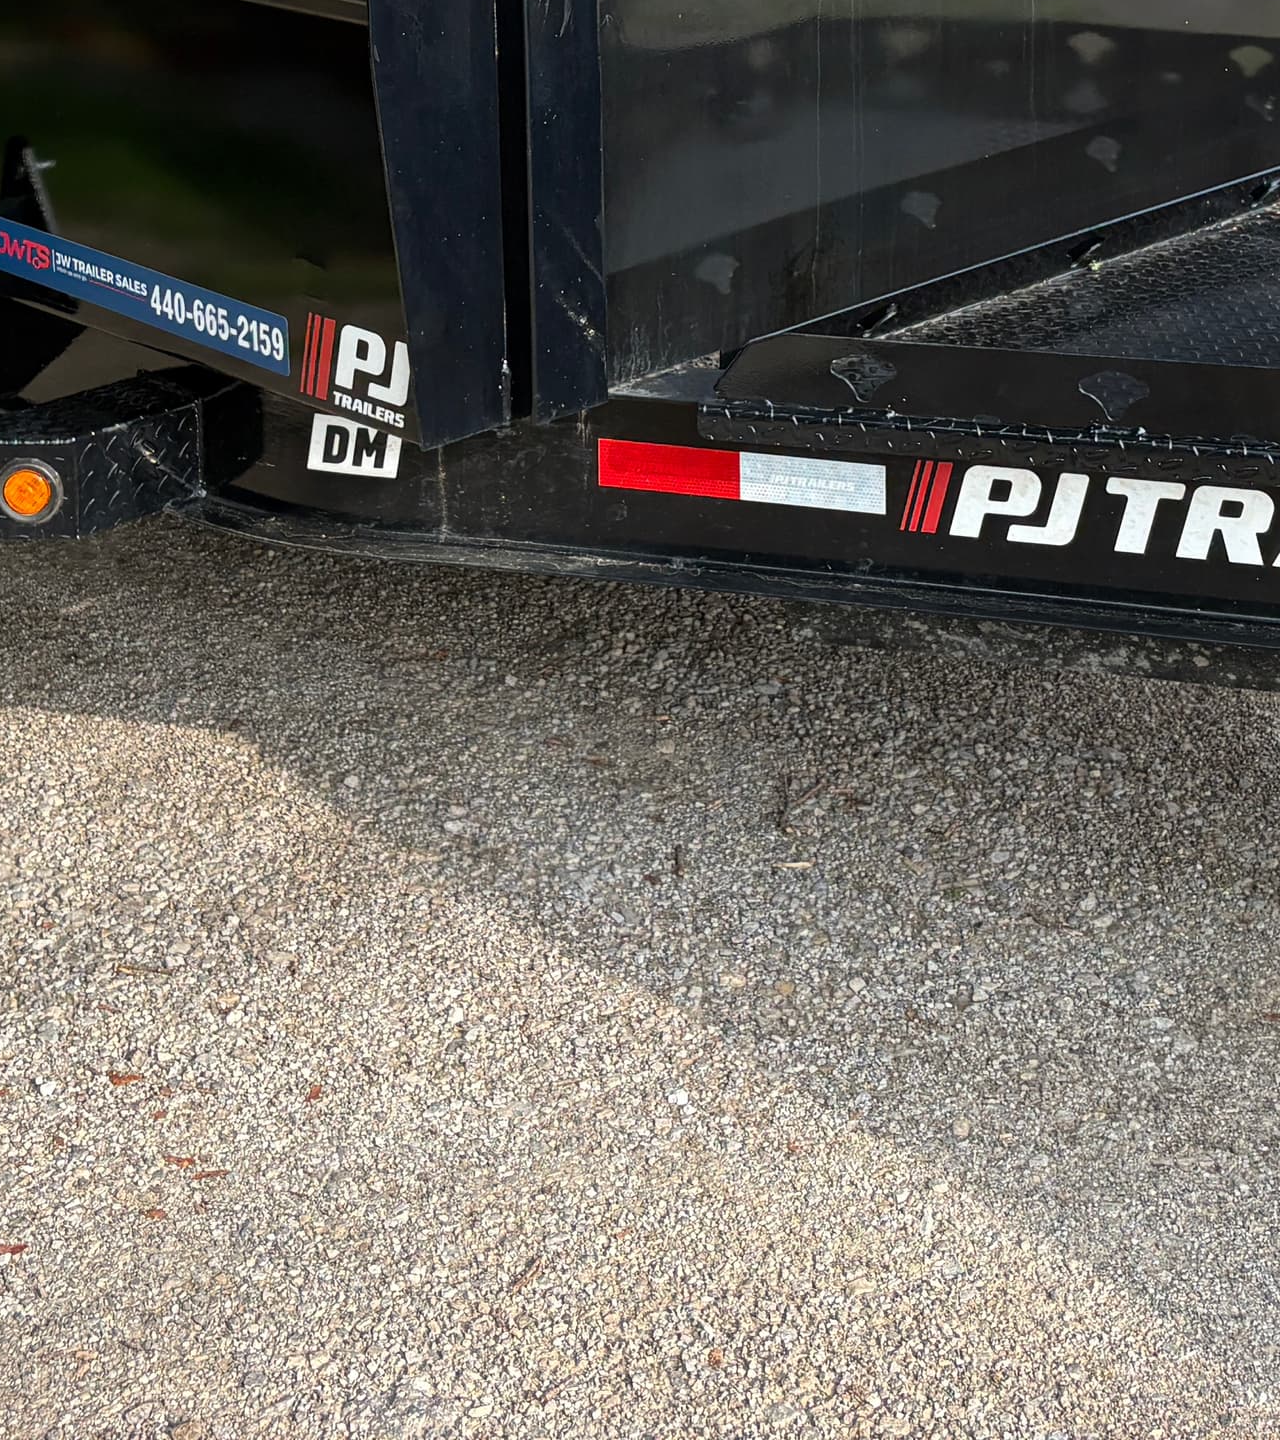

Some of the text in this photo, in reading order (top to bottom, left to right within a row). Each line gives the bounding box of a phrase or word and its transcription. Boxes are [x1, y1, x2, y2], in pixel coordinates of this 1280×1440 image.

[55, 252, 71, 269] JW
[73, 258, 114, 285] TRAILER
[115, 274, 147, 296] SALES
[150, 285, 284, 361] 440-665-2159
[335, 324, 410, 406] PJ
[333, 391, 405, 428] TRAILERS
[322, 423, 389, 470] DM
